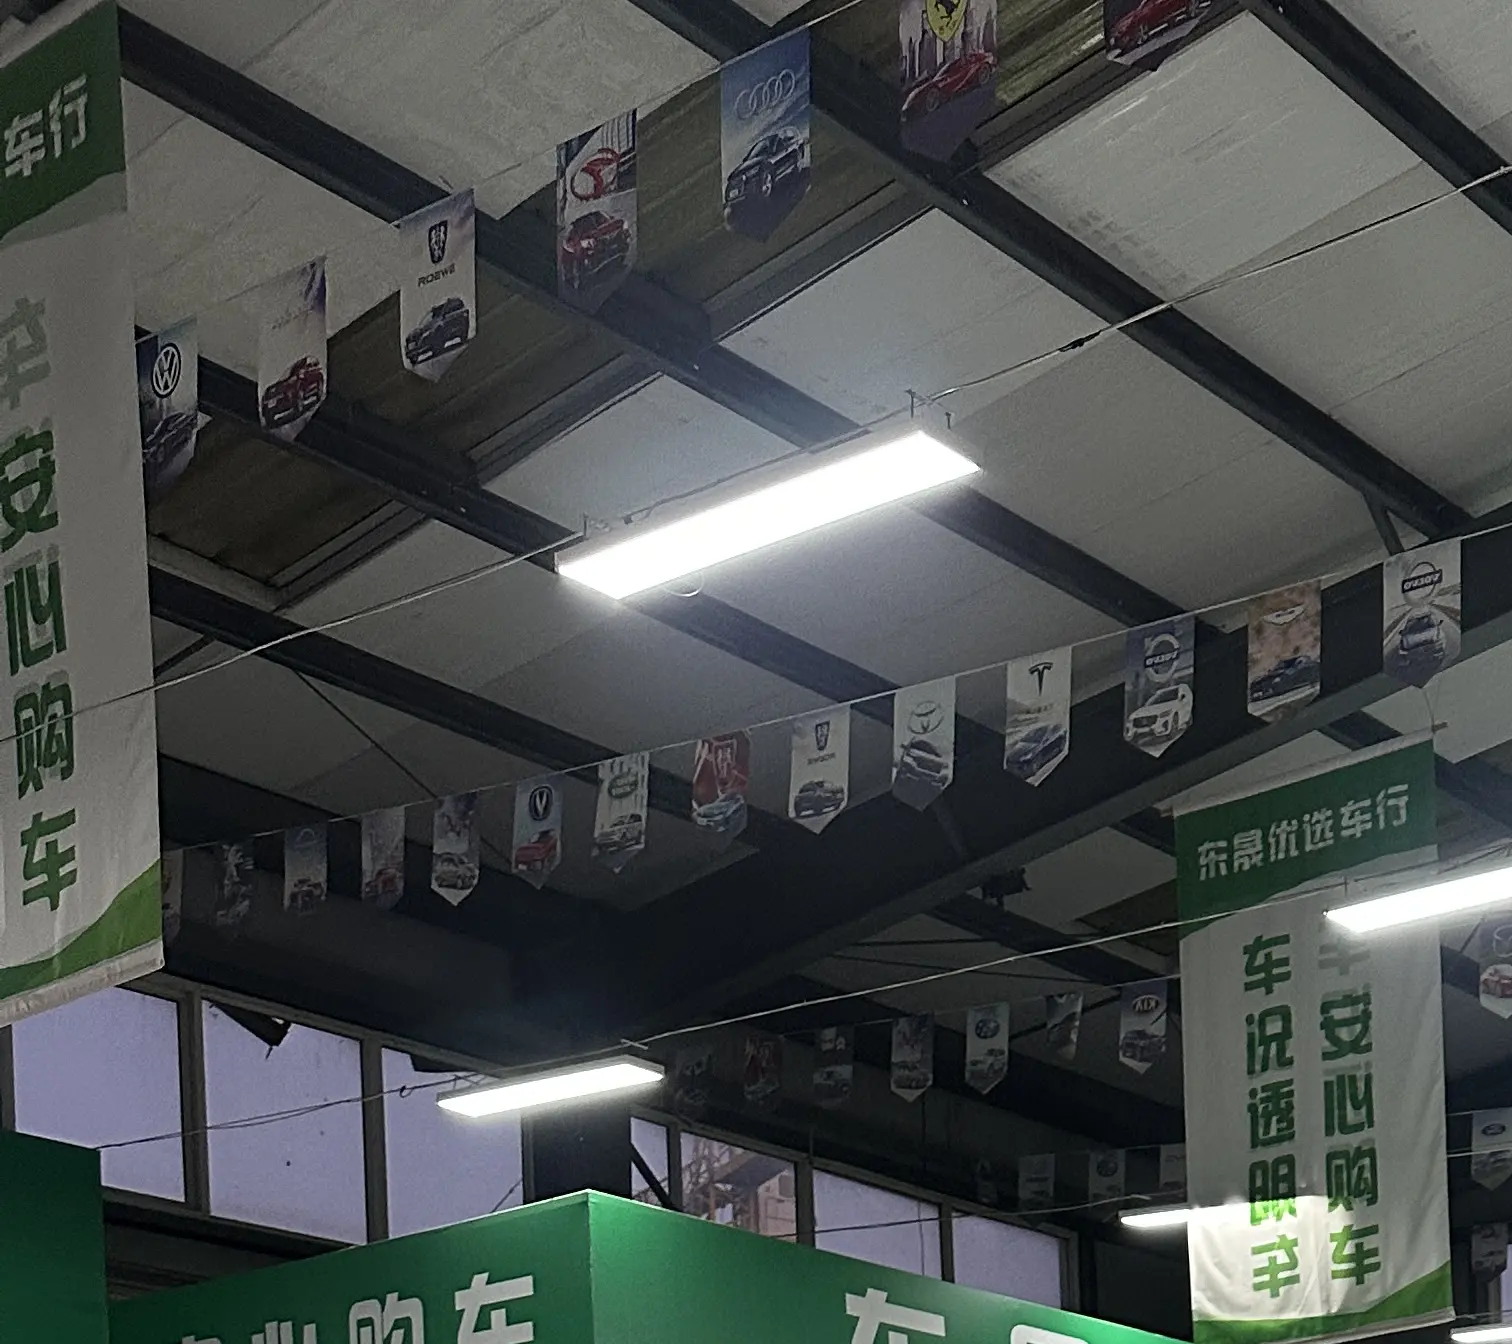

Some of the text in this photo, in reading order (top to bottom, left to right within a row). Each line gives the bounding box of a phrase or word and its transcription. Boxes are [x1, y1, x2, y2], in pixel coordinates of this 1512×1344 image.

[3, 74, 88, 178] 车行
[1196, 782, 1411, 882] 东晟优选车行
[1319, 984, 1381, 1286] 安心购车
